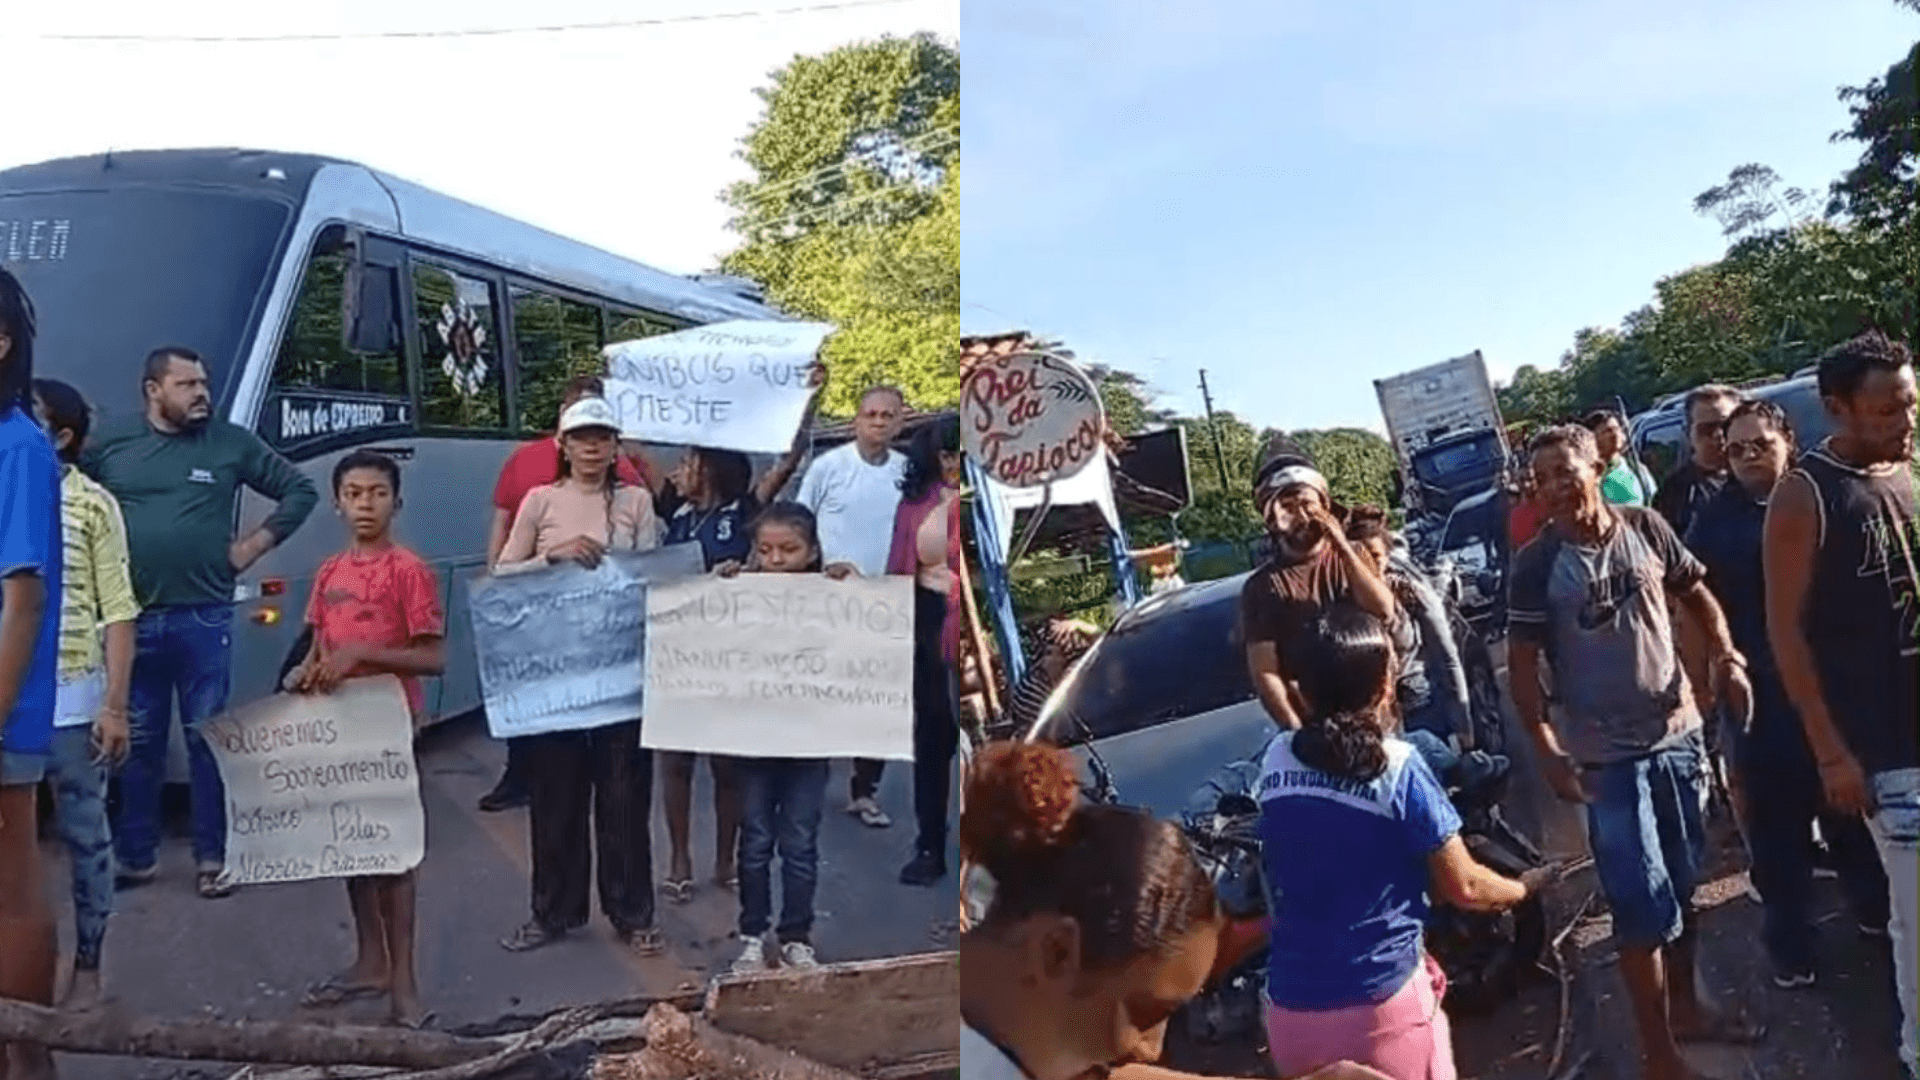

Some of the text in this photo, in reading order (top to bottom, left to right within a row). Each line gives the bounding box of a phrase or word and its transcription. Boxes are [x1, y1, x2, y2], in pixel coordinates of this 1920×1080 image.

[1008, 395, 1047, 426] da
[980, 414, 1098, 486] Tapioca
[263, 750, 408, 794] Saneamento
